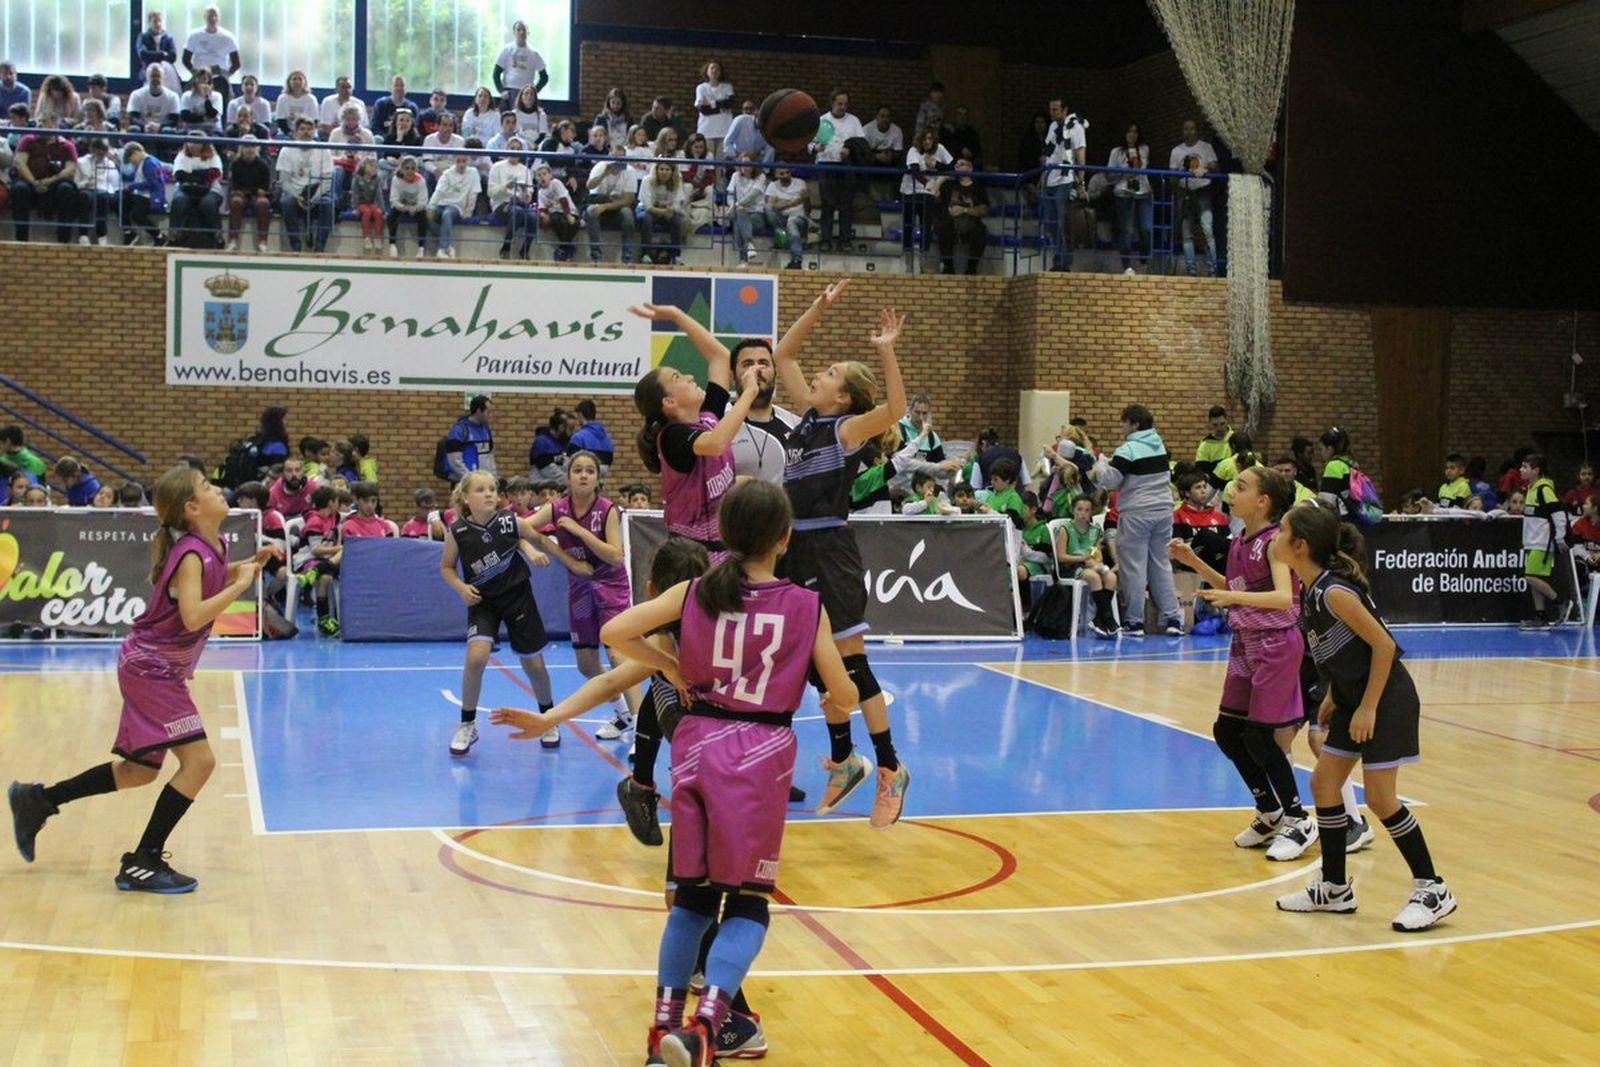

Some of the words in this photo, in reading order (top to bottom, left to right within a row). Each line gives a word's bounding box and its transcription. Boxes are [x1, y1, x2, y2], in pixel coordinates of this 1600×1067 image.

[264, 277, 625, 363] Benahavís
[173, 362, 391, 386] www.benahavis.es
[475, 354, 552, 376] Paraiso
[557, 356, 641, 379] Natural
[79, 531, 137, 542] RESPETA
[498, 516, 514, 534] 35
[1375, 549, 1468, 569] Federación
[1472, 550, 1529, 568] Andal
[1412, 573, 1435, 593] de
[1440, 573, 1527, 593] Baloncesto
[40, 587, 146, 626] cesto
[712, 611, 785, 706] 93
